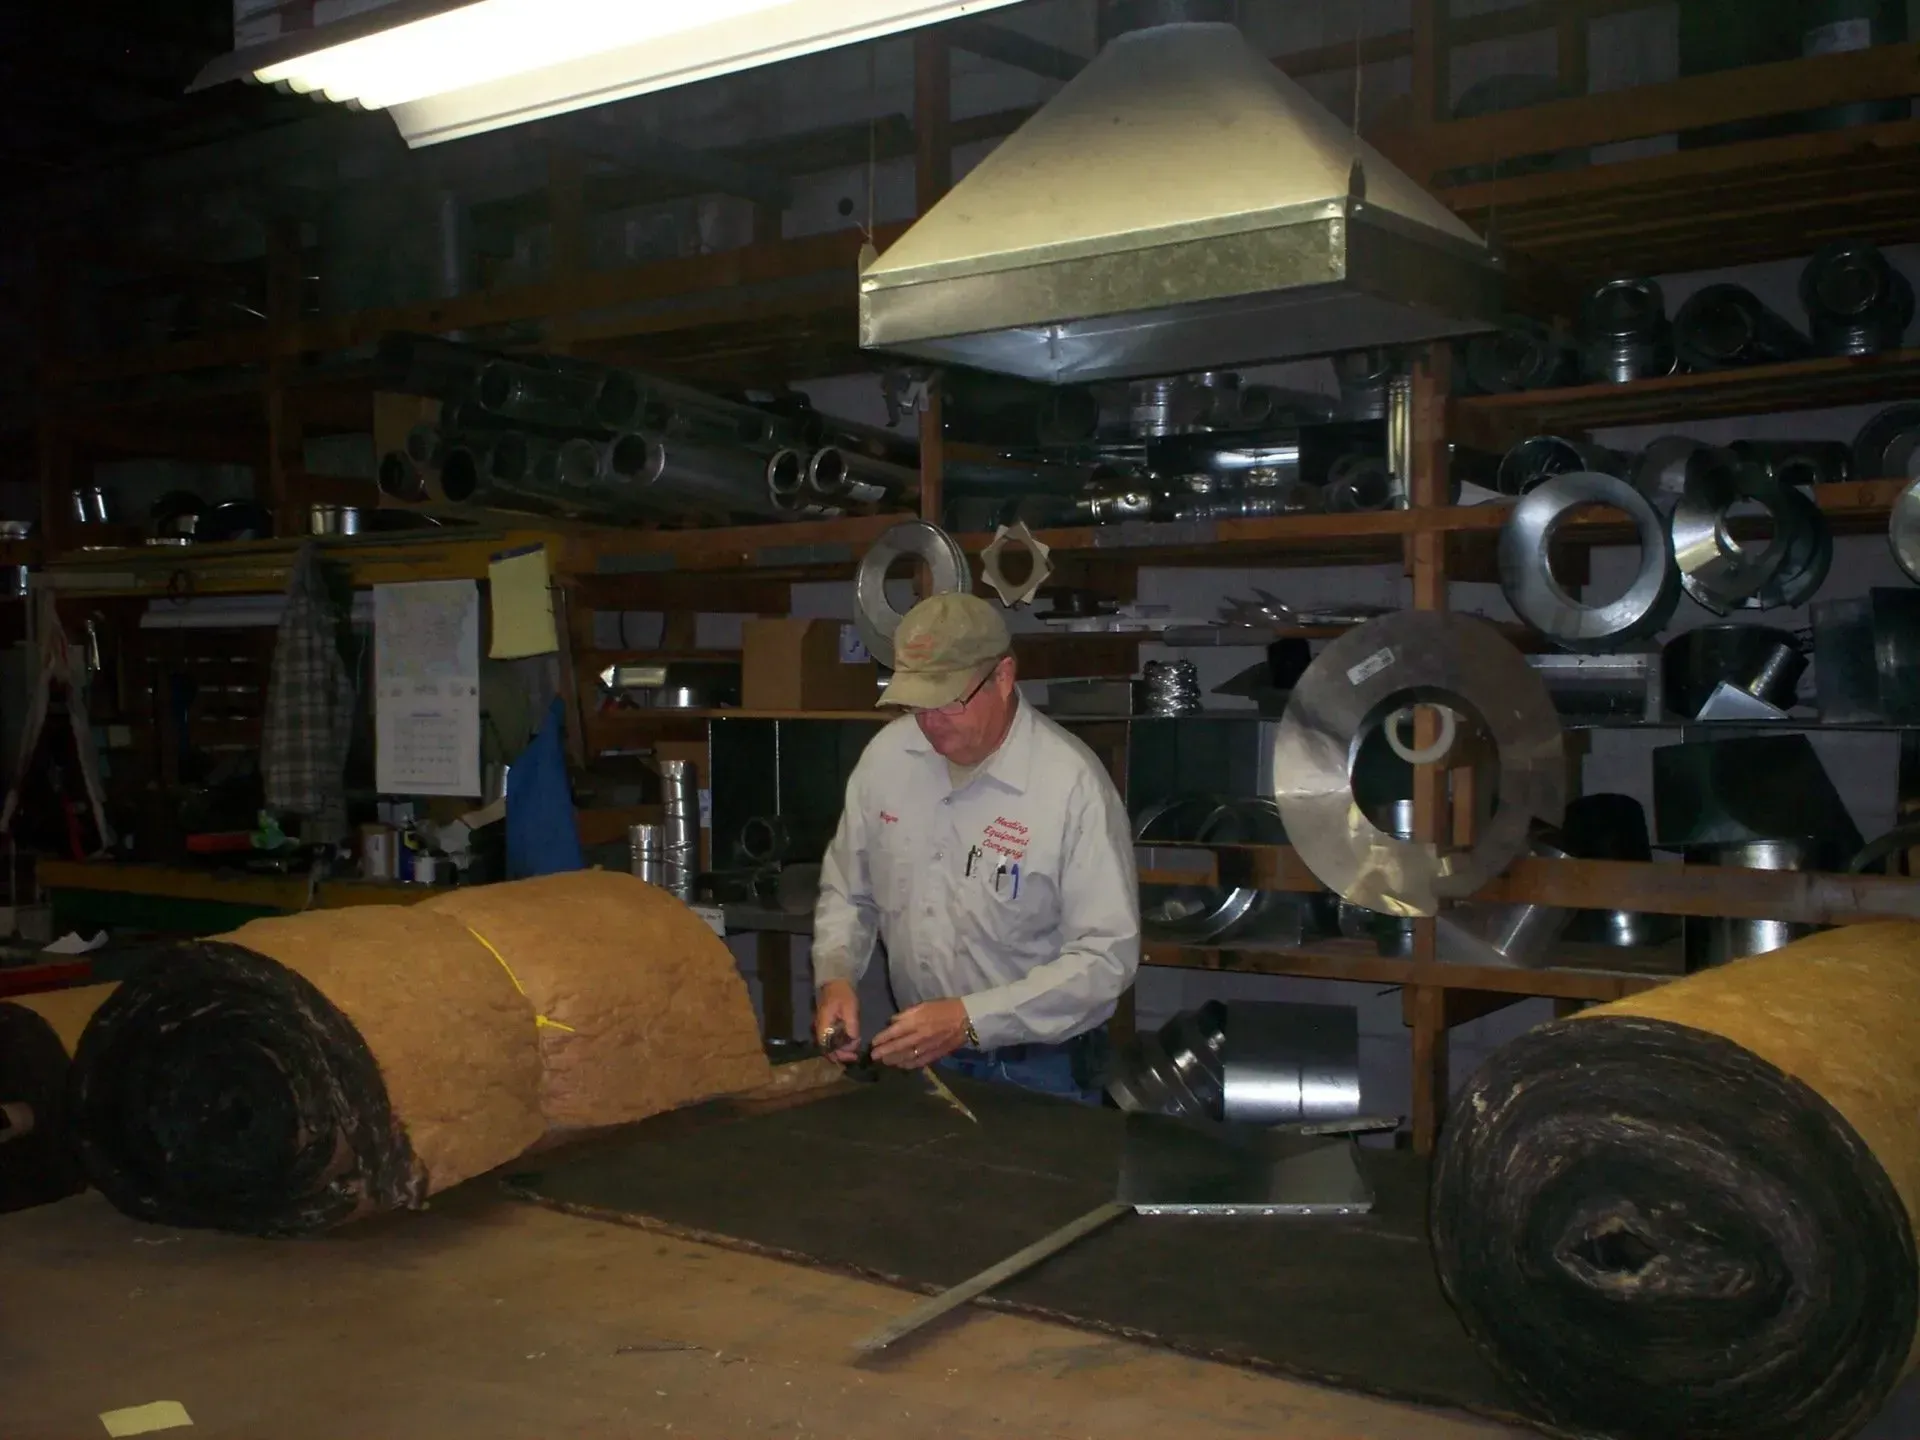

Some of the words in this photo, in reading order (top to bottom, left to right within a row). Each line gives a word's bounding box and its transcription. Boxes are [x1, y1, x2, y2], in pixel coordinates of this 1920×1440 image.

[983, 825, 1030, 846] Equipment
[994, 816, 1028, 835] Heating
[982, 839, 1024, 860] Company
